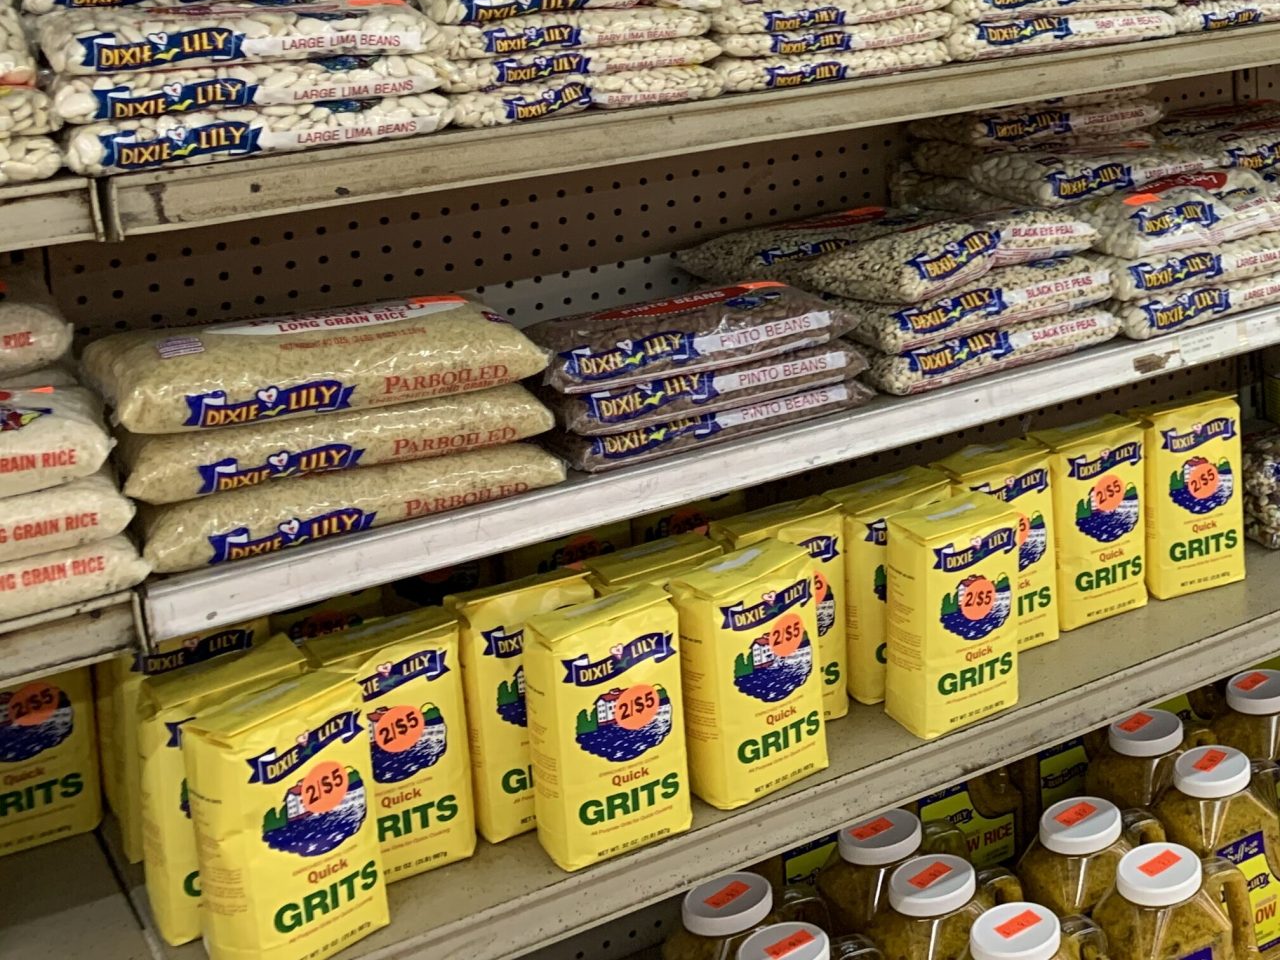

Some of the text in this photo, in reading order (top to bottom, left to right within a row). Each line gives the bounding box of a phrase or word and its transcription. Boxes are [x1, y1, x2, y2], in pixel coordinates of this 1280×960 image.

[101, 30, 227, 66] DIXIE LILY
[517, 104, 549, 118] DIXIE
[561, 85, 583, 103] LILY
[608, 95, 631, 103] BABY
[656, 91, 688, 100] BEANS
[121, 120, 417, 164] DIXIE LILY LARGE LIMA BEANS
[1146, 269, 1173, 288] DIXIE
[1186, 256, 1212, 274] LILY
[1236, 255, 1258, 268] LARGE
[1259, 252, 1277, 264] LIMA
[910, 306, 946, 328] DIXIE
[960, 291, 992, 310] LILY
[1026, 286, 1053, 298] BLACK
[1072, 276, 1092, 288] PEAS
[278, 310, 408, 332] LONG GRAIN RICE
[580, 316, 811, 374] DIXIE LILY PINTO BEANS
[602, 357, 827, 417] DIXIE LILY PINTO BEANS
[205, 401, 259, 426] DIXIE
[287, 386, 338, 412] LILY
[1171, 421, 1226, 450] DIXIE LILY
[42, 449, 76, 467] RICE
[219, 468, 271, 489] DIXIE
[300, 445, 353, 470] LILY
[1096, 480, 1121, 504] 2/$5
[1191, 470, 1215, 493] 2/$5
[13, 513, 98, 541] GRAIN RICE
[311, 513, 359, 540] LILY
[1192, 519, 1217, 534] Quick
[947, 532, 1010, 568] DIXIE LILY
[1169, 530, 1238, 562] GRITS
[22, 556, 104, 587] GRAIN RICE
[1075, 555, 1142, 592] GRITS
[734, 584, 805, 626] DIXIE LILY
[964, 590, 992, 607] 2/$5
[772, 623, 801, 647] 2/$5
[580, 638, 658, 683] DIXIE LILY
[965, 644, 993, 661] Quick
[938, 652, 1013, 695] GRITS
[618, 692, 656, 719] 2/$5
[379, 711, 419, 745] 2/$5
[737, 710, 820, 764] GRITS
[266, 713, 347, 780] DIXIE LILY
[305, 769, 344, 804] 2/$5
[612, 767, 649, 786] Quick
[381, 788, 422, 808] Quick
[579, 772, 679, 825] GRITS
[307, 858, 348, 884] Quick
[274, 860, 379, 933] GRITS
